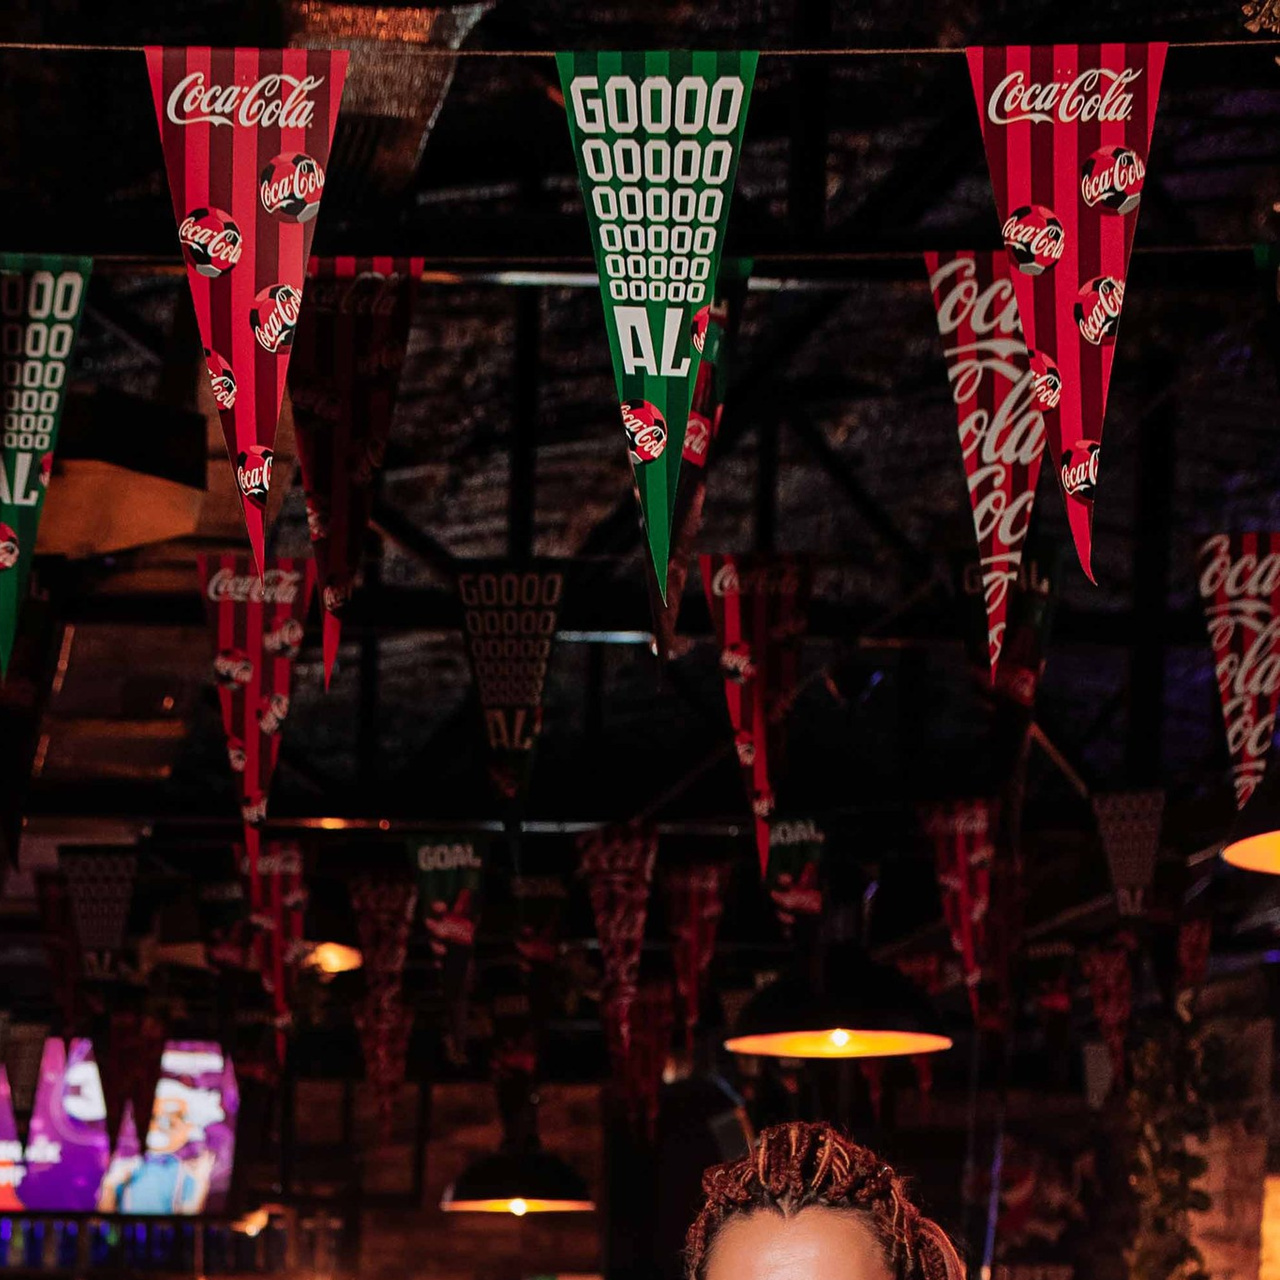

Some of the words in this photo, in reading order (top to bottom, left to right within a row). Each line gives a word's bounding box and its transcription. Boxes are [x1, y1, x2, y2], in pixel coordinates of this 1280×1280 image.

[167, 71, 325, 128] Coca-Cola
[570, 75, 744, 135] GOOOO
[988, 67, 1143, 124] Coca-Cola
[613, 305, 692, 378] AL
